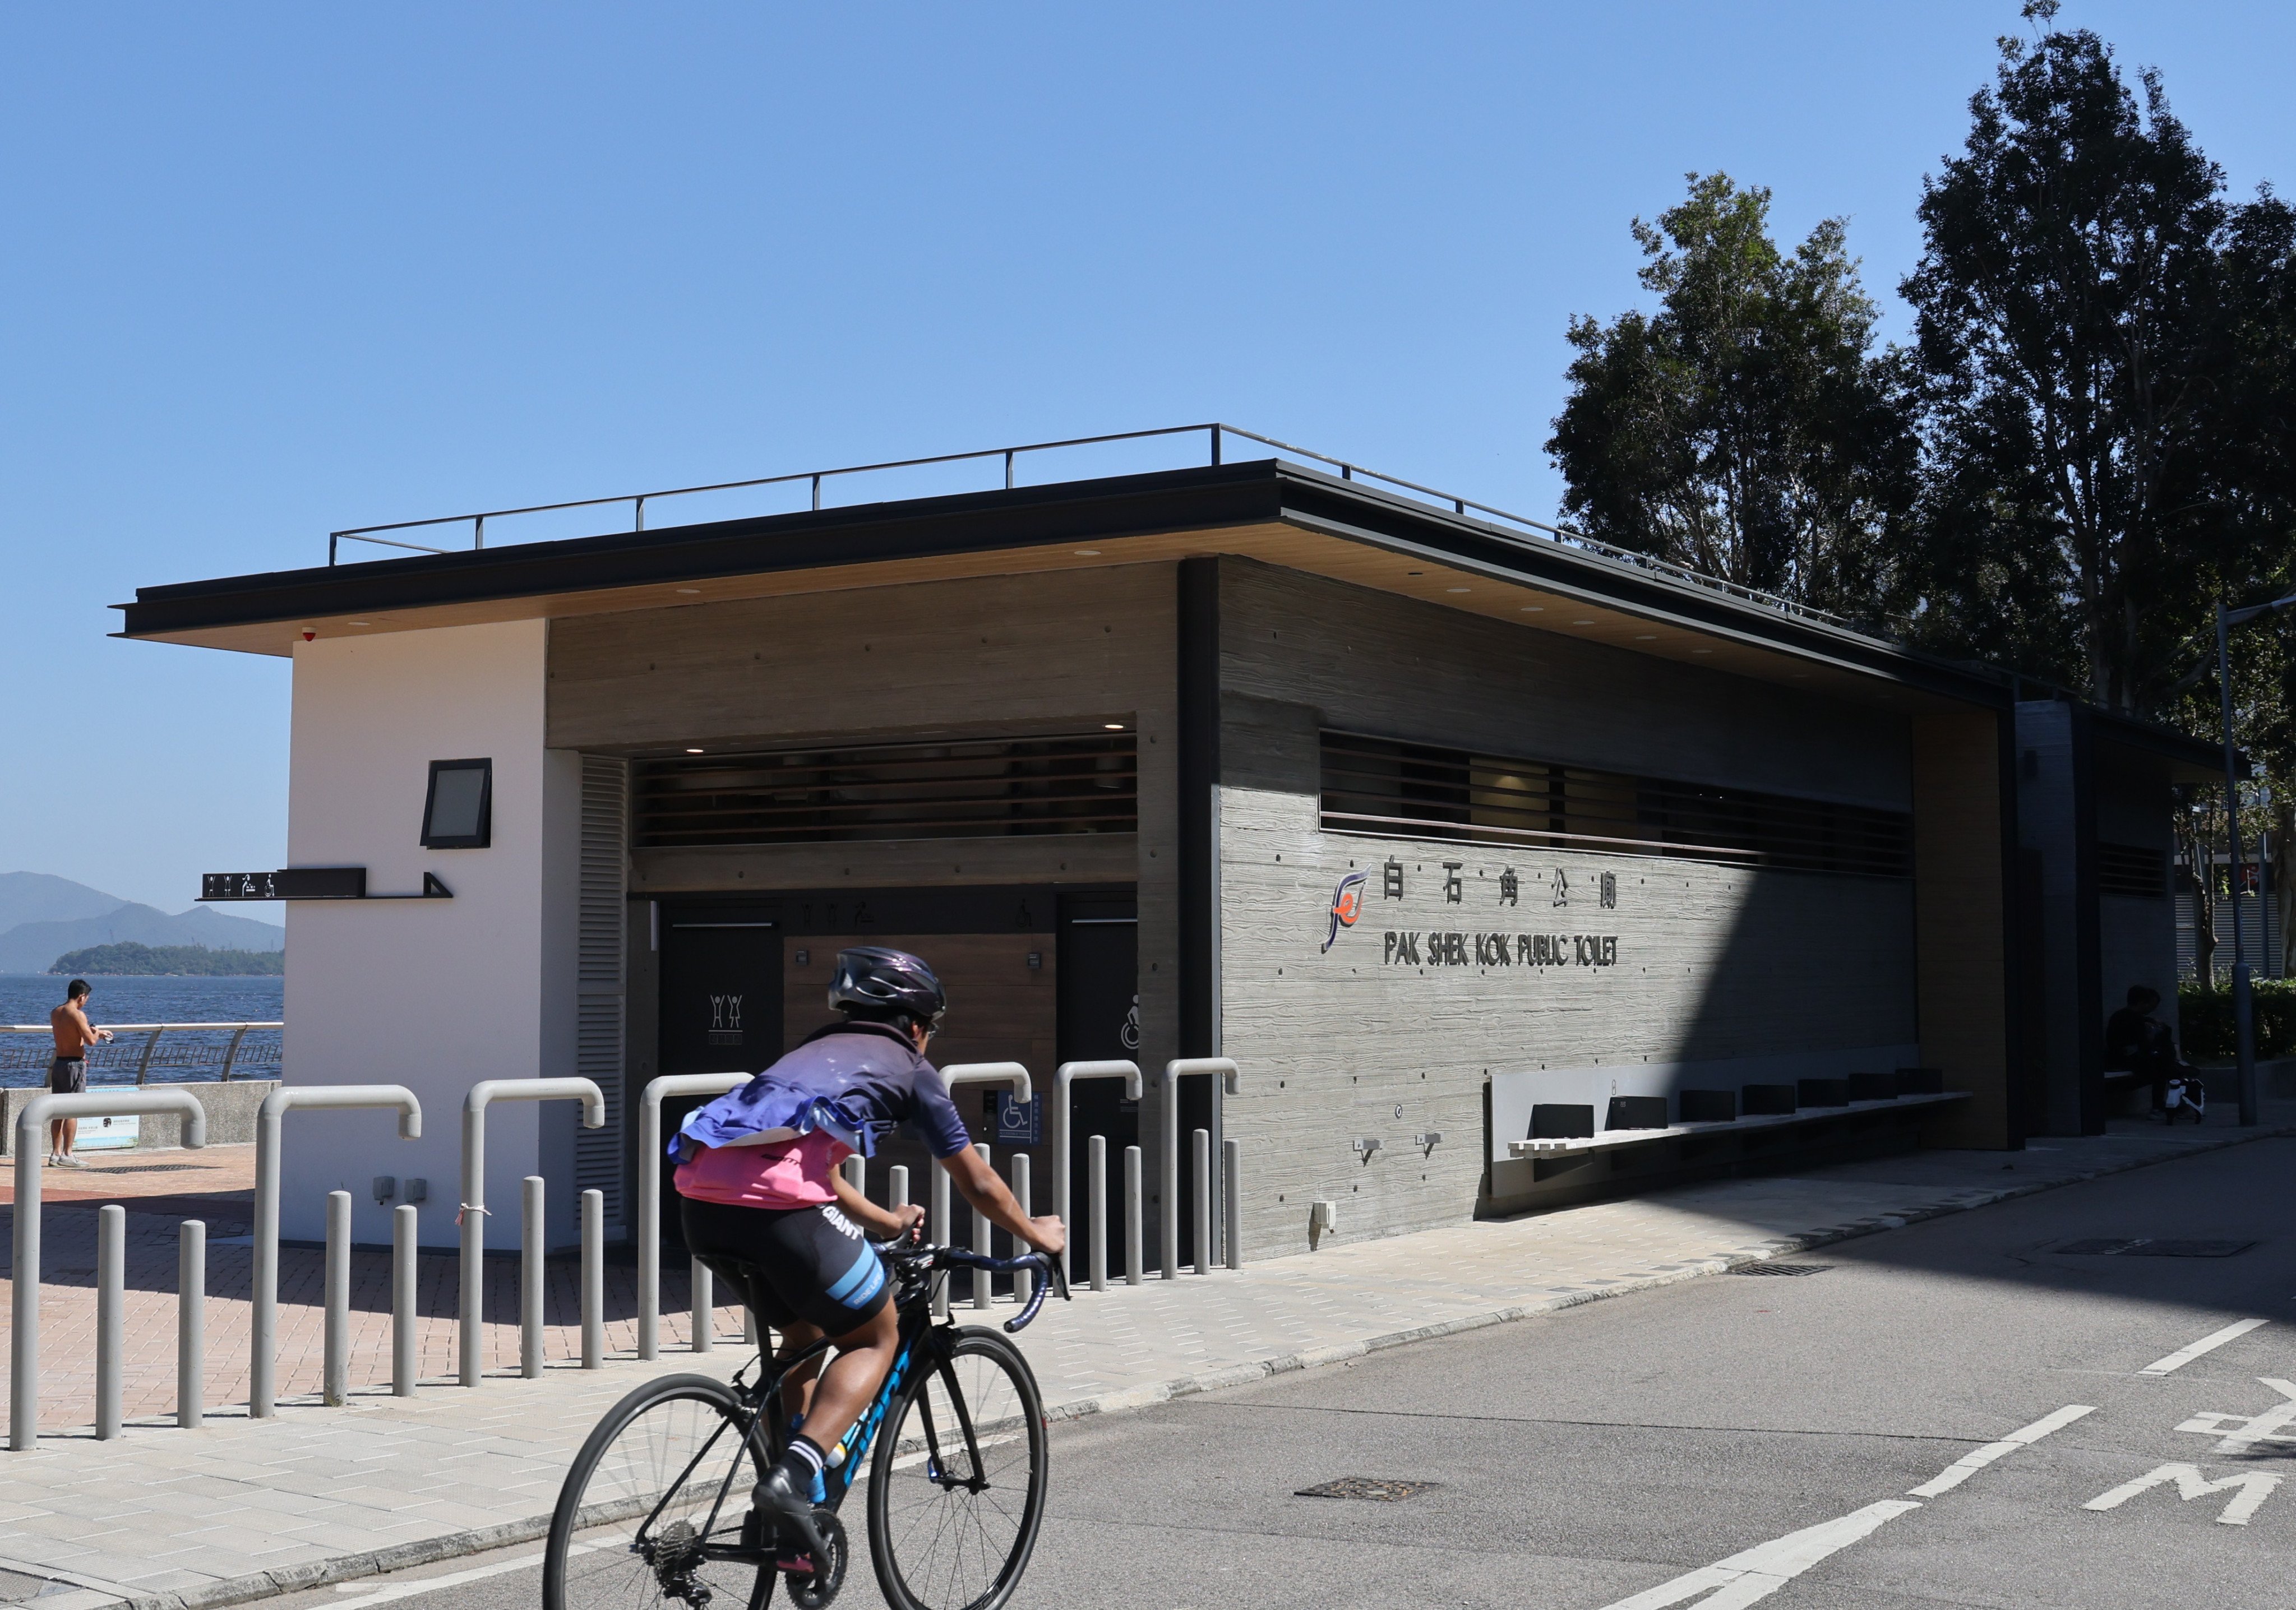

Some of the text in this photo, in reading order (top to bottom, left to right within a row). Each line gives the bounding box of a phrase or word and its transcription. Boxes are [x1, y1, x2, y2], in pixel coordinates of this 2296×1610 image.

[1384, 854, 1616, 909] 白石角公園
[1384, 932, 1618, 966] PAK SHEK KOK PUBLIC TOILET
[823, 1206, 861, 1241] GIANT
[853, 1287, 872, 1306] RIDE
